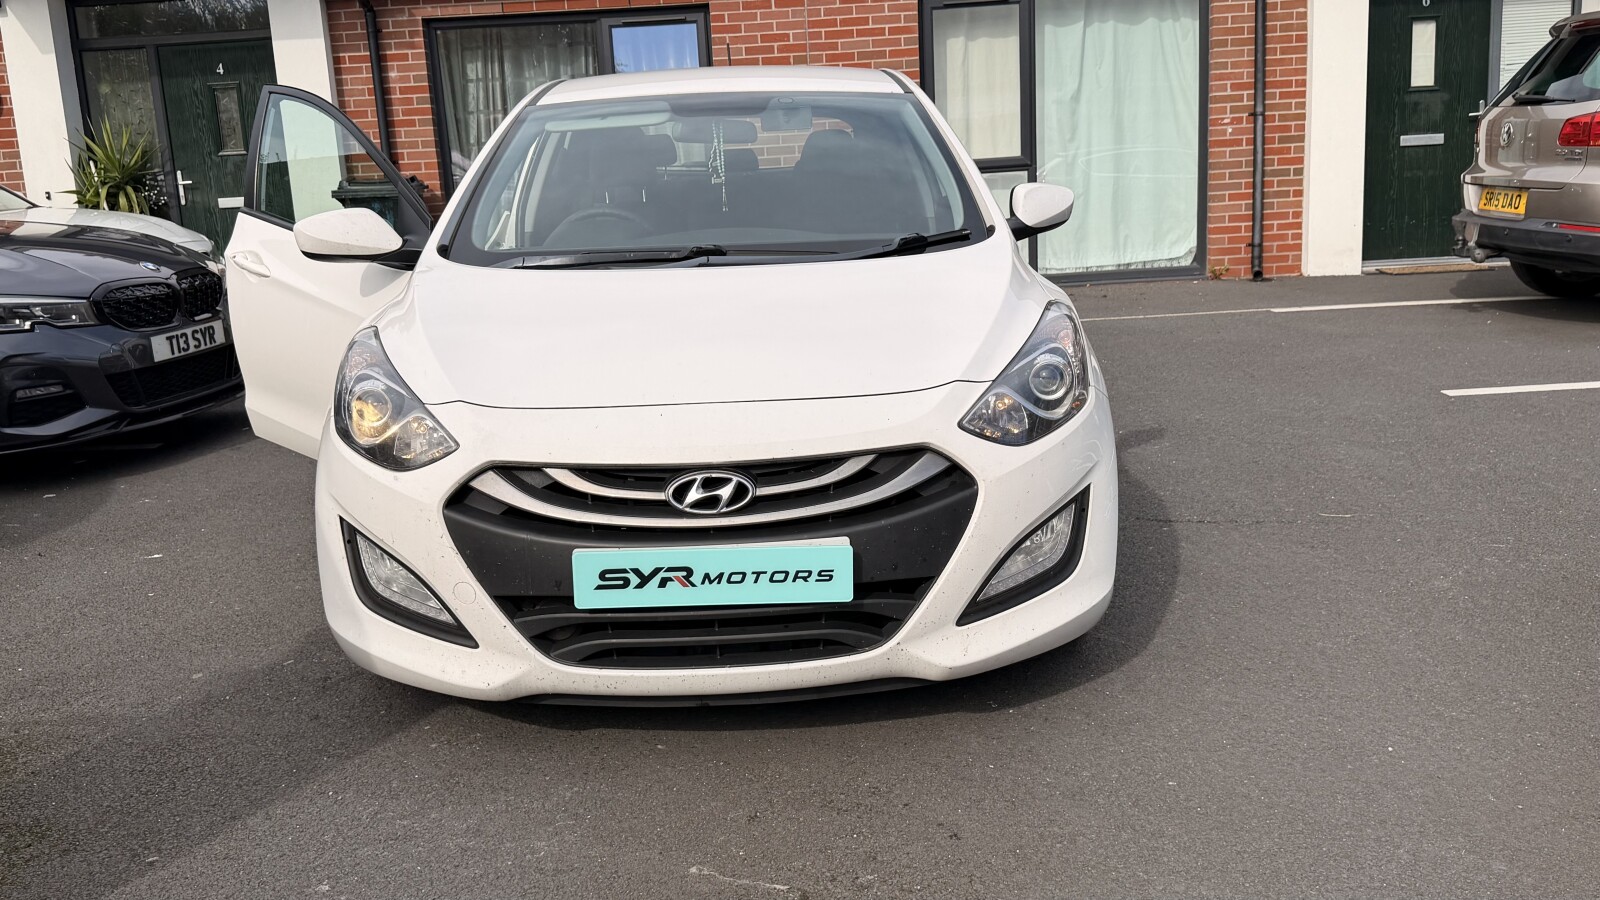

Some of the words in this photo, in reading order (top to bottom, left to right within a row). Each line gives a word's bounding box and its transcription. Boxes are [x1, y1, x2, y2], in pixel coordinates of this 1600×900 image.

[216, 62, 224, 75] 4
[1483, 191, 1500, 207] SR15
[1501, 194, 1522, 210] DAO
[165, 332, 190, 356] T13
[191, 325, 216, 349] SYR
[593, 566, 698, 590] SYR
[701, 569, 835, 586] MOTORS
